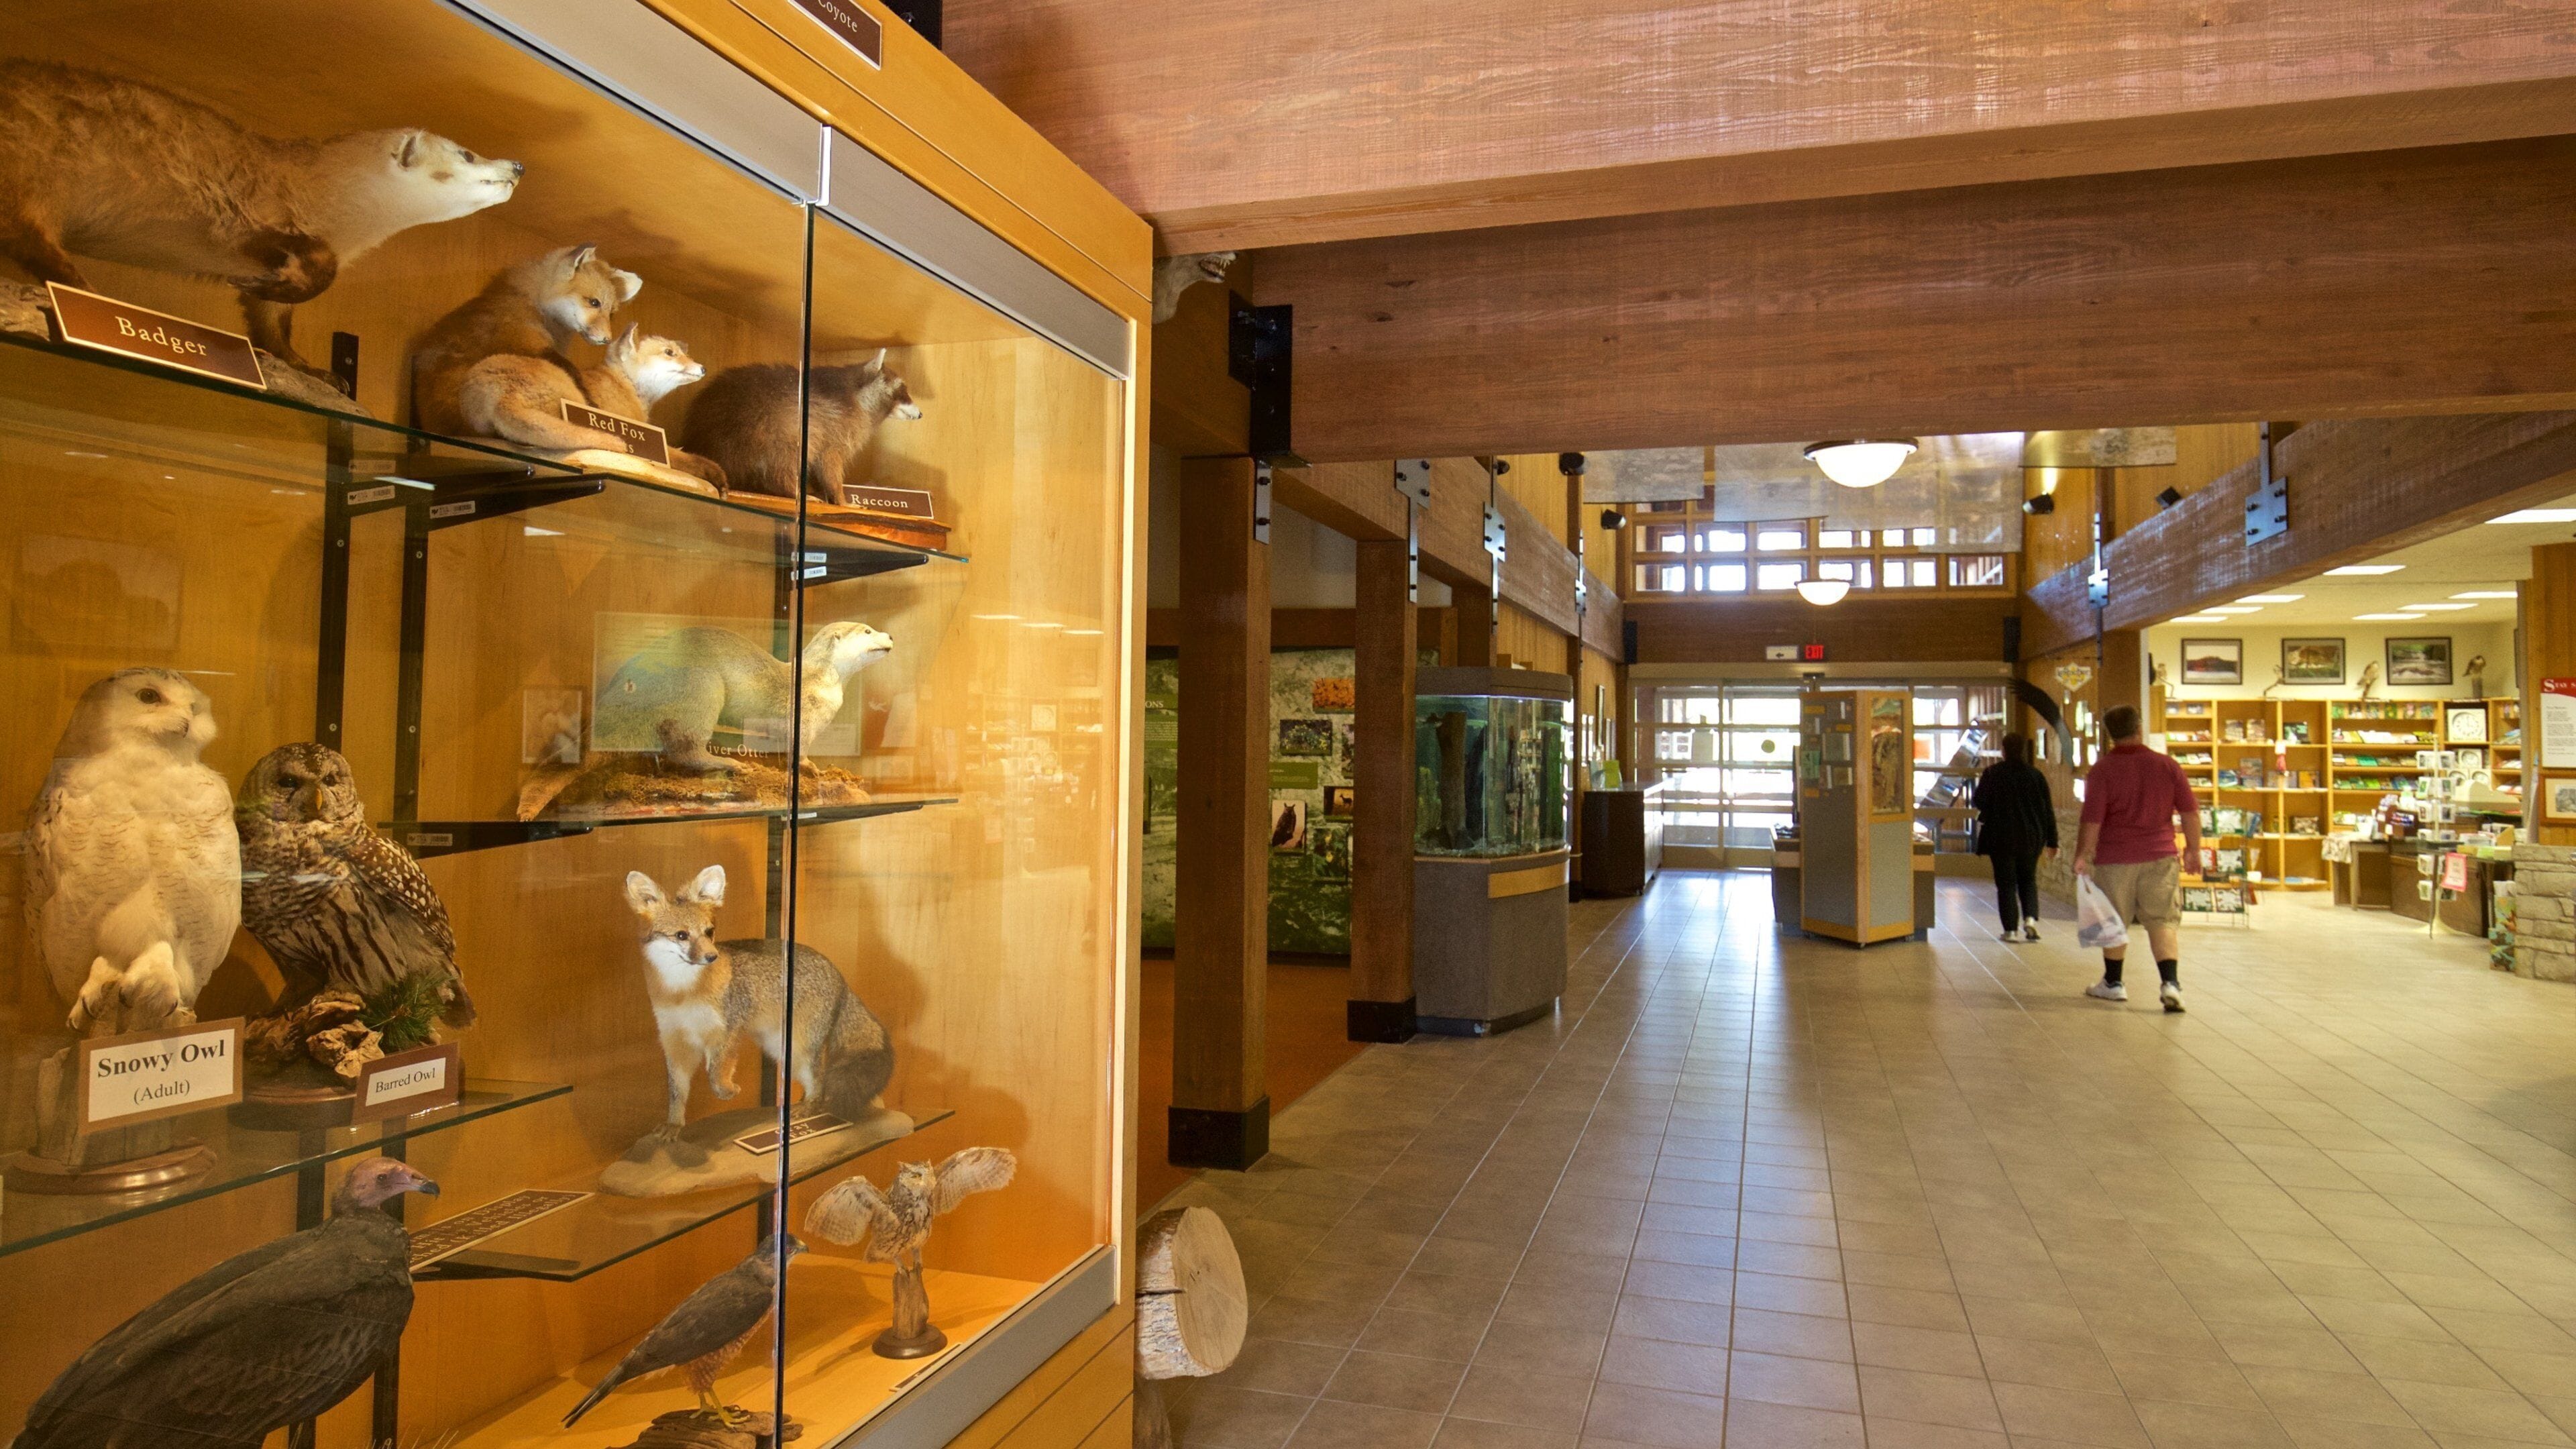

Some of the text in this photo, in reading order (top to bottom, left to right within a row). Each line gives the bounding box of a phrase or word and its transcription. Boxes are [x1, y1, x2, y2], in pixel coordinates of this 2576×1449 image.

[115, 315, 207, 356] Badger
[588, 412, 645, 441] Red Fox
[851, 494, 908, 508] Raccoon
[1805, 644, 1824, 659] EXIT
[1145, 700, 1164, 709] ONS
[708, 741, 769, 758] iver Otter
[98, 1039, 225, 1078] Snowy Owl
[375, 1067, 435, 1093] Barred Owl
[133, 1079, 191, 1106] (Adult)
[775, 1123, 810, 1134] Gay
[790, 1129, 816, 1138] Fox
[472, 1195, 531, 1216] Display
